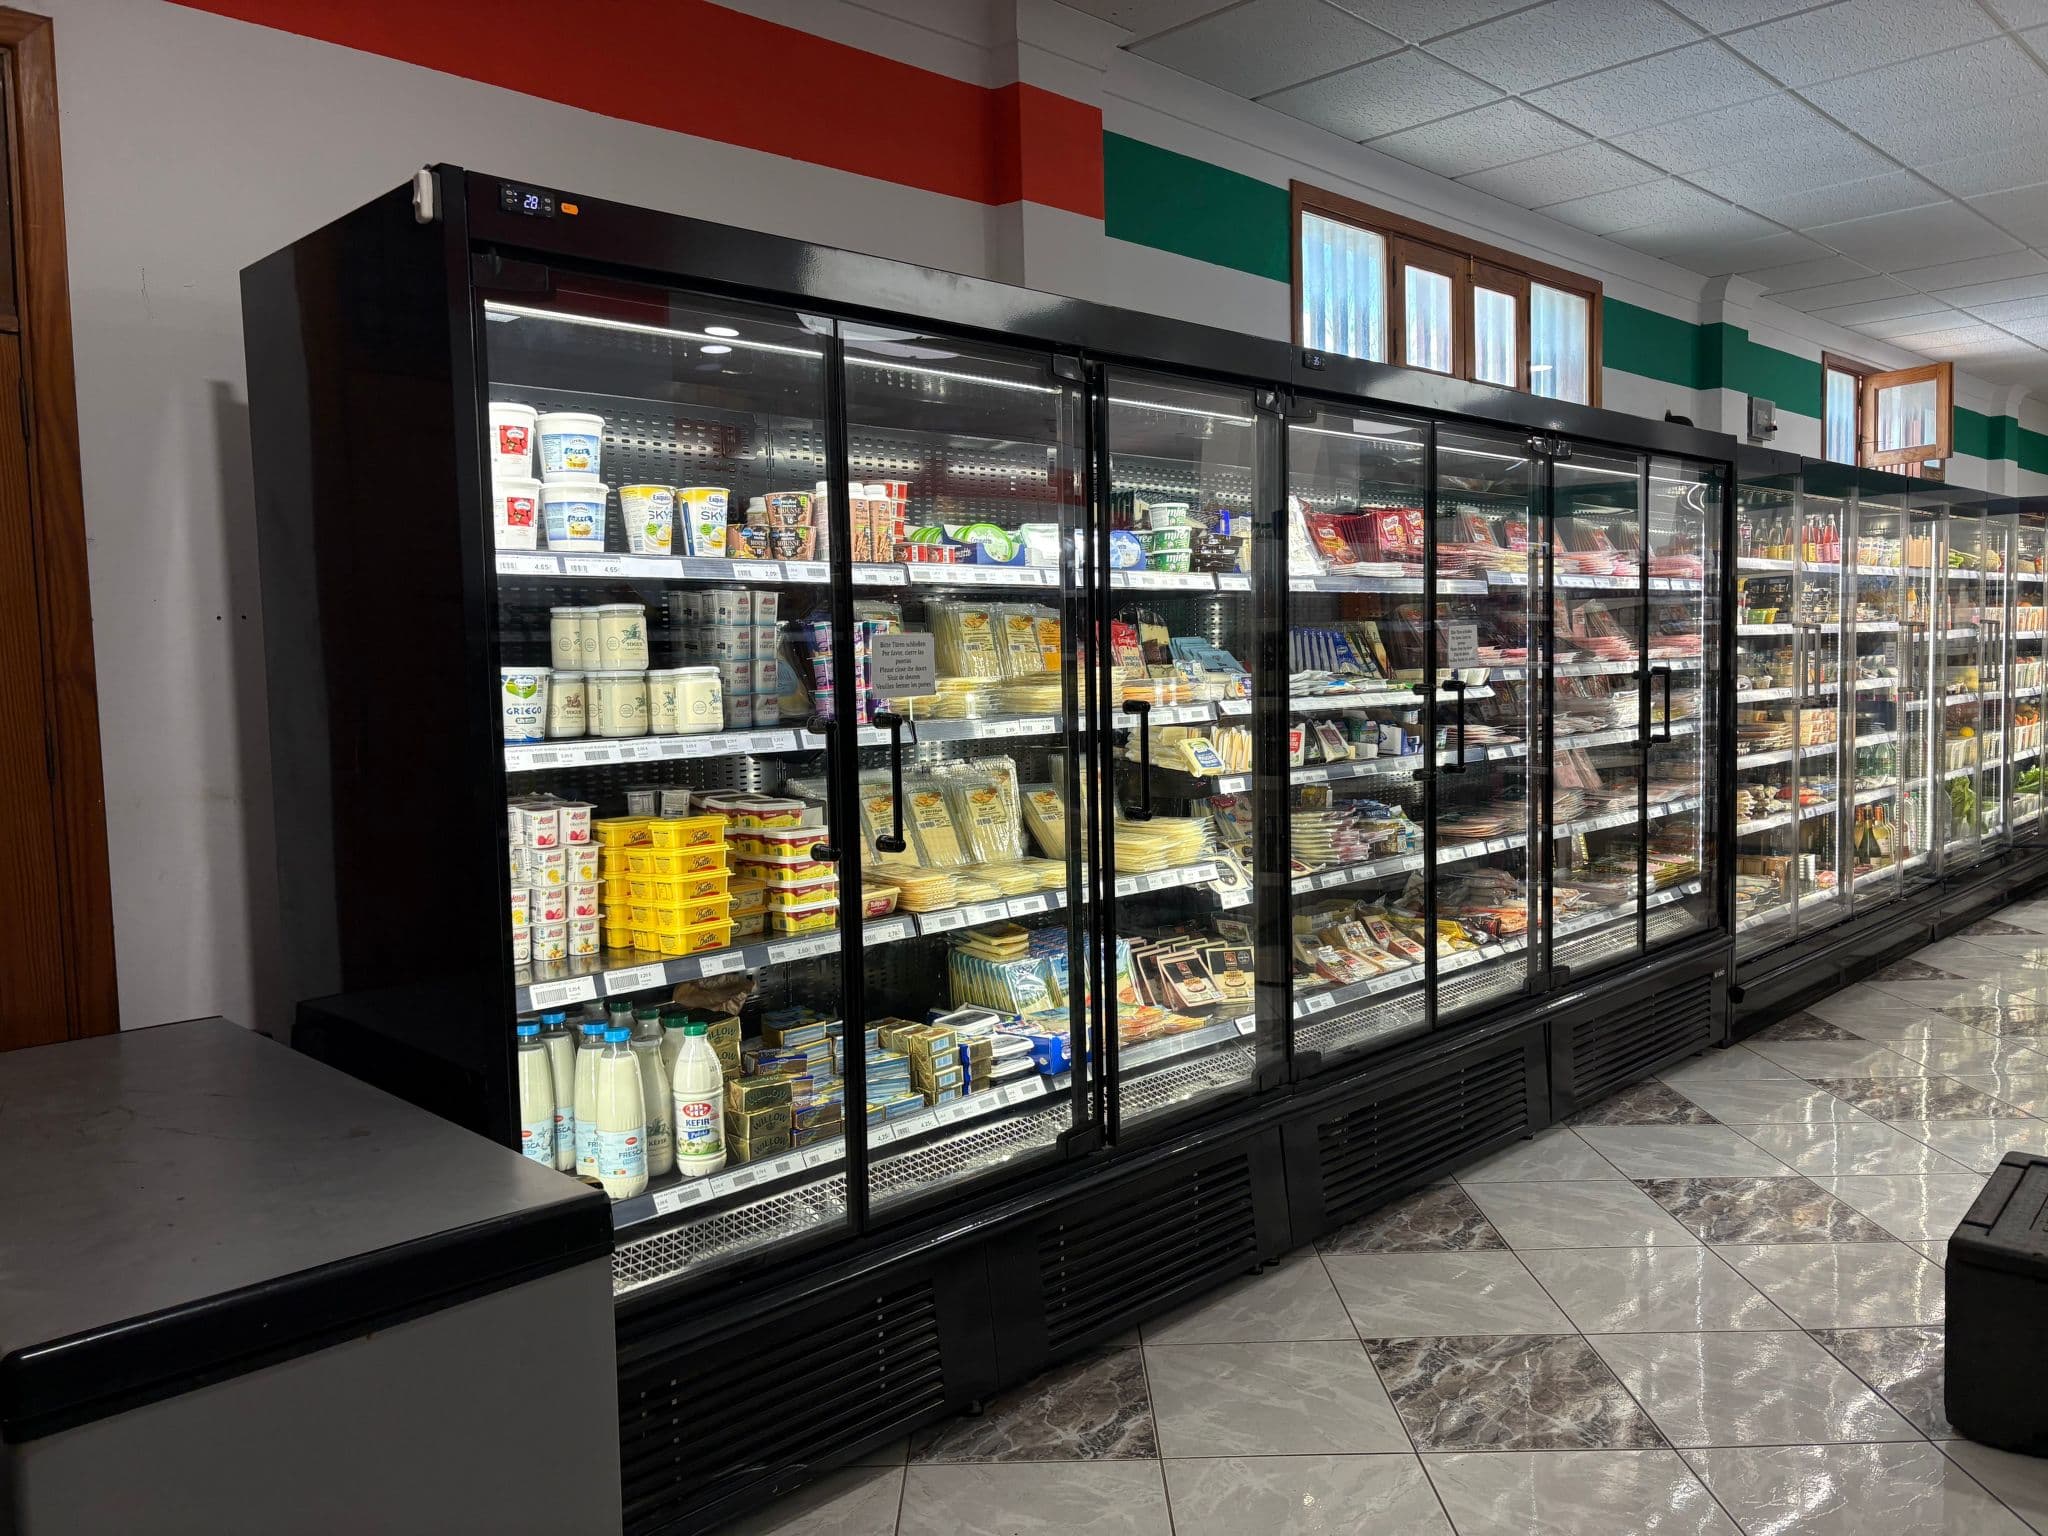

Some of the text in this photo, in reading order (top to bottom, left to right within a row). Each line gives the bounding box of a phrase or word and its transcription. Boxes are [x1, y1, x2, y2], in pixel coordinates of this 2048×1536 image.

[524, 194, 538, 210] 28
[506, 706, 542, 715] GRIEGO
[707, 1026, 737, 1042] ILLOW
[686, 1118, 710, 1127] KEFIR
[753, 1112, 787, 1131] WILLOW
[756, 1136, 787, 1154] WILLOW
